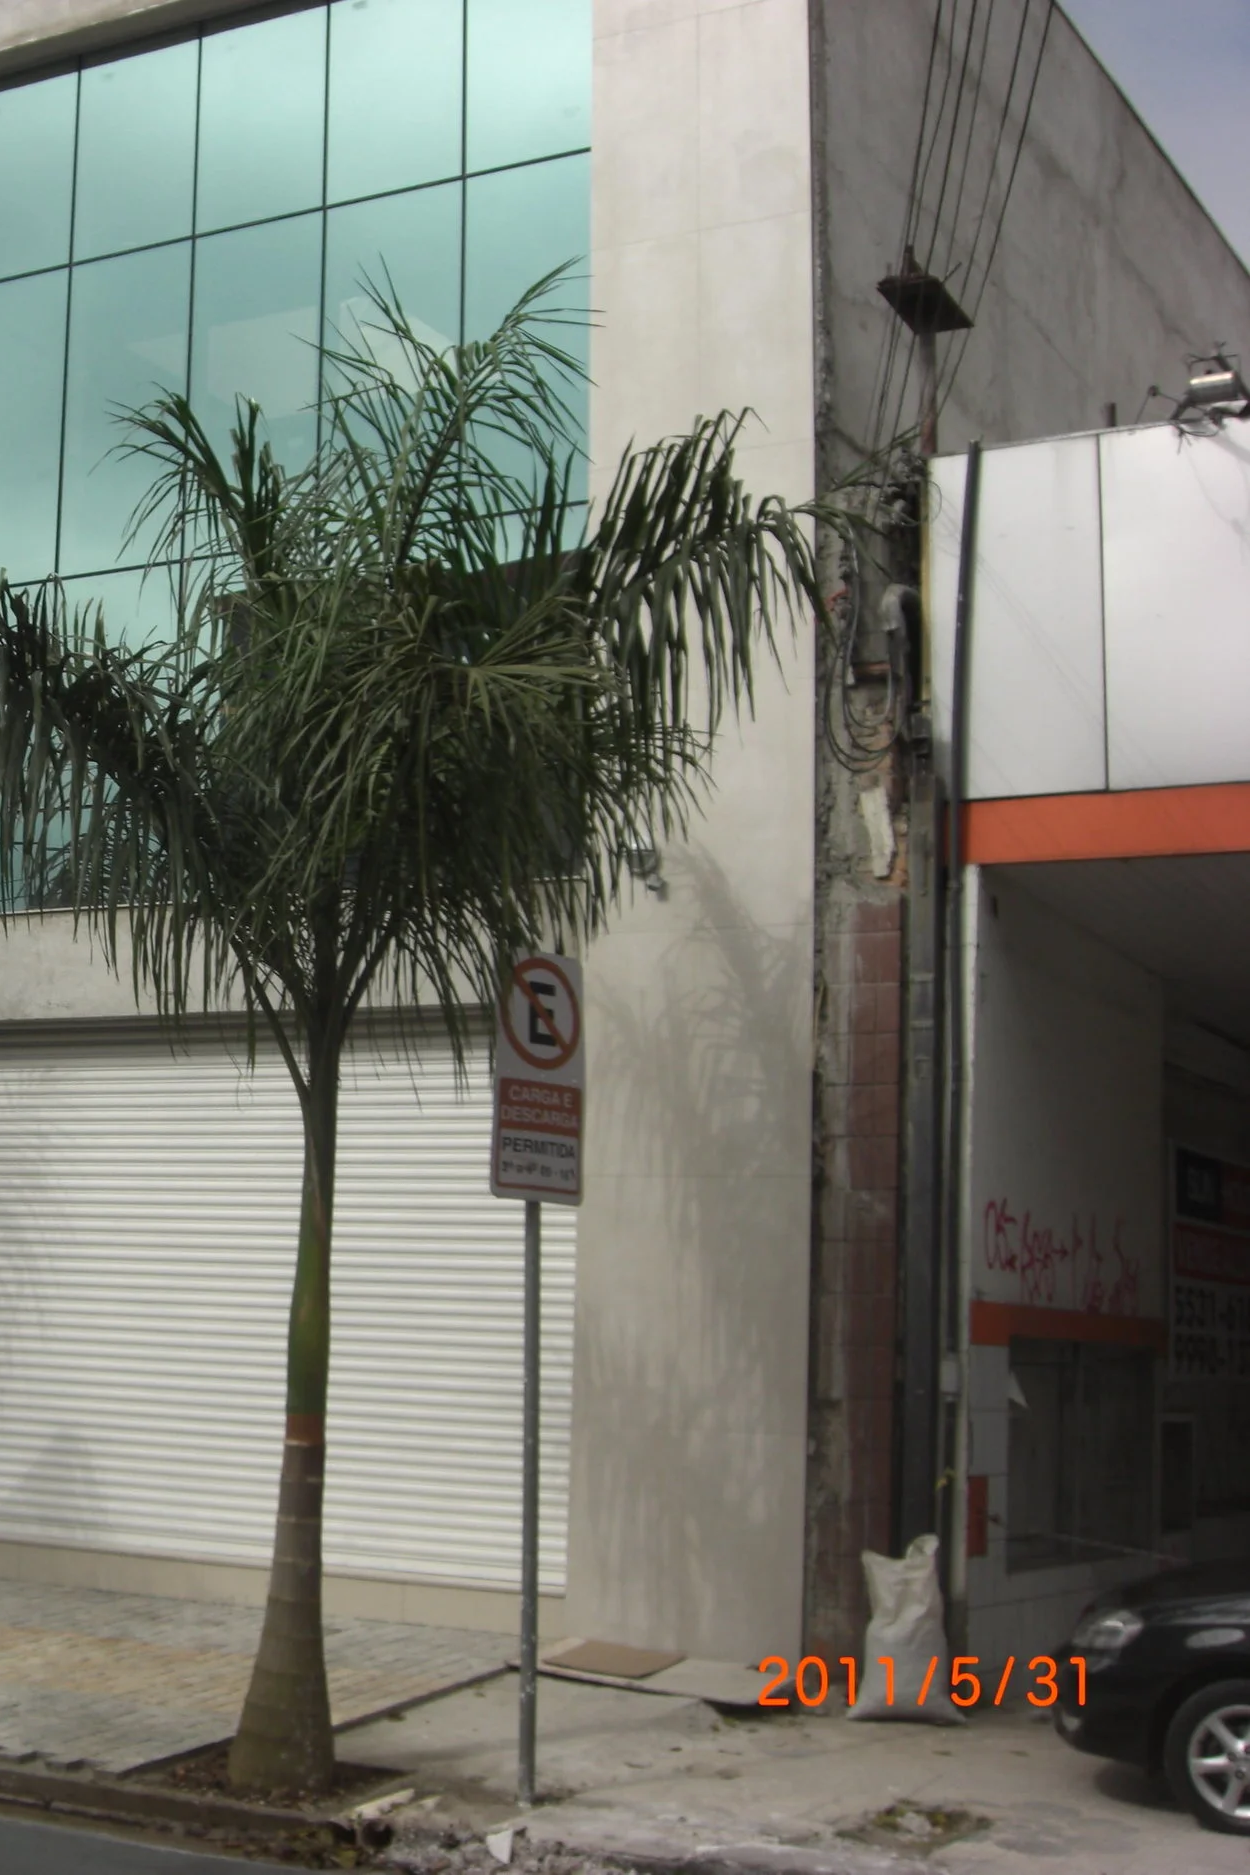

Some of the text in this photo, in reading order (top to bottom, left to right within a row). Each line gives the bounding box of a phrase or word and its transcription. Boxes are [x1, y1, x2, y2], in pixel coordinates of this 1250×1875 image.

[508, 1085, 573, 1108] CARGA E
[501, 1105, 578, 1128] DESCARGA
[502, 1136, 575, 1159] PERMITIDA
